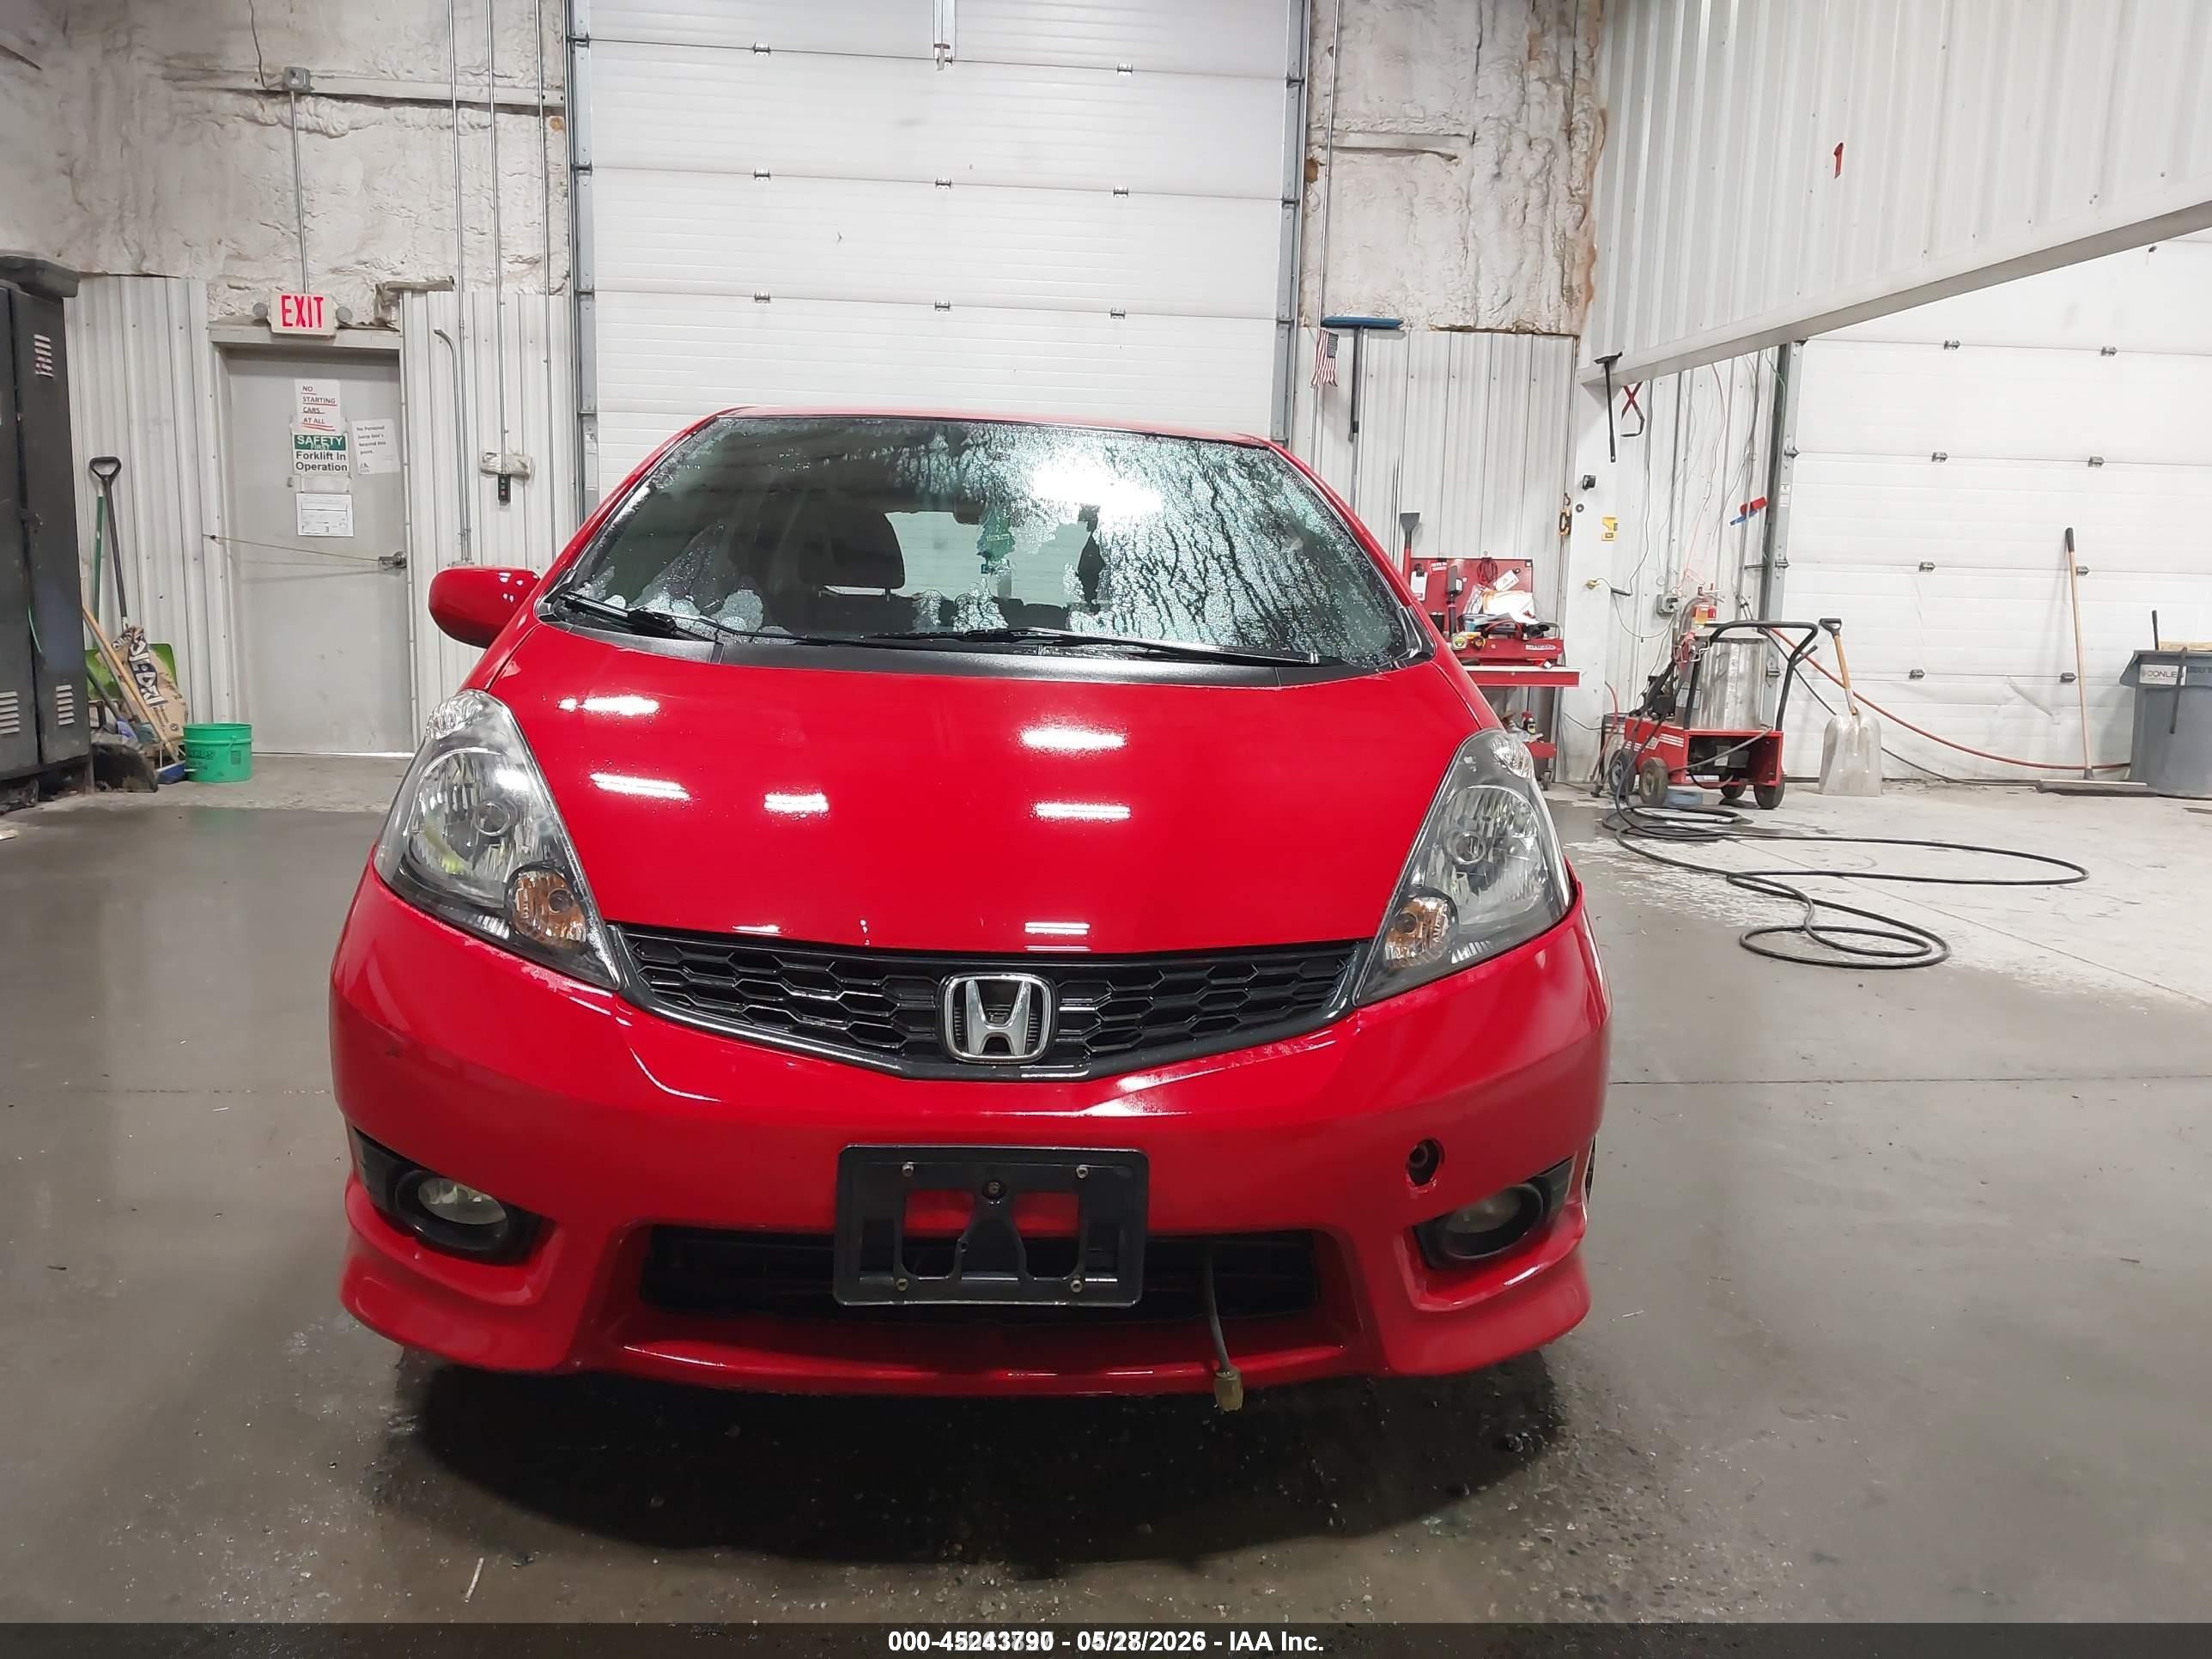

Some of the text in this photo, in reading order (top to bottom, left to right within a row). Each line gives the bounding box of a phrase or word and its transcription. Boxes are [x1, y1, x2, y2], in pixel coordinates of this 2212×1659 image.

[281, 295, 324, 328] EXIT
[302, 396, 336, 404] STARTING
[296, 434, 343, 446] SAFETY
[295, 451, 347, 461] Forklift In
[295, 461, 348, 472] Operation
